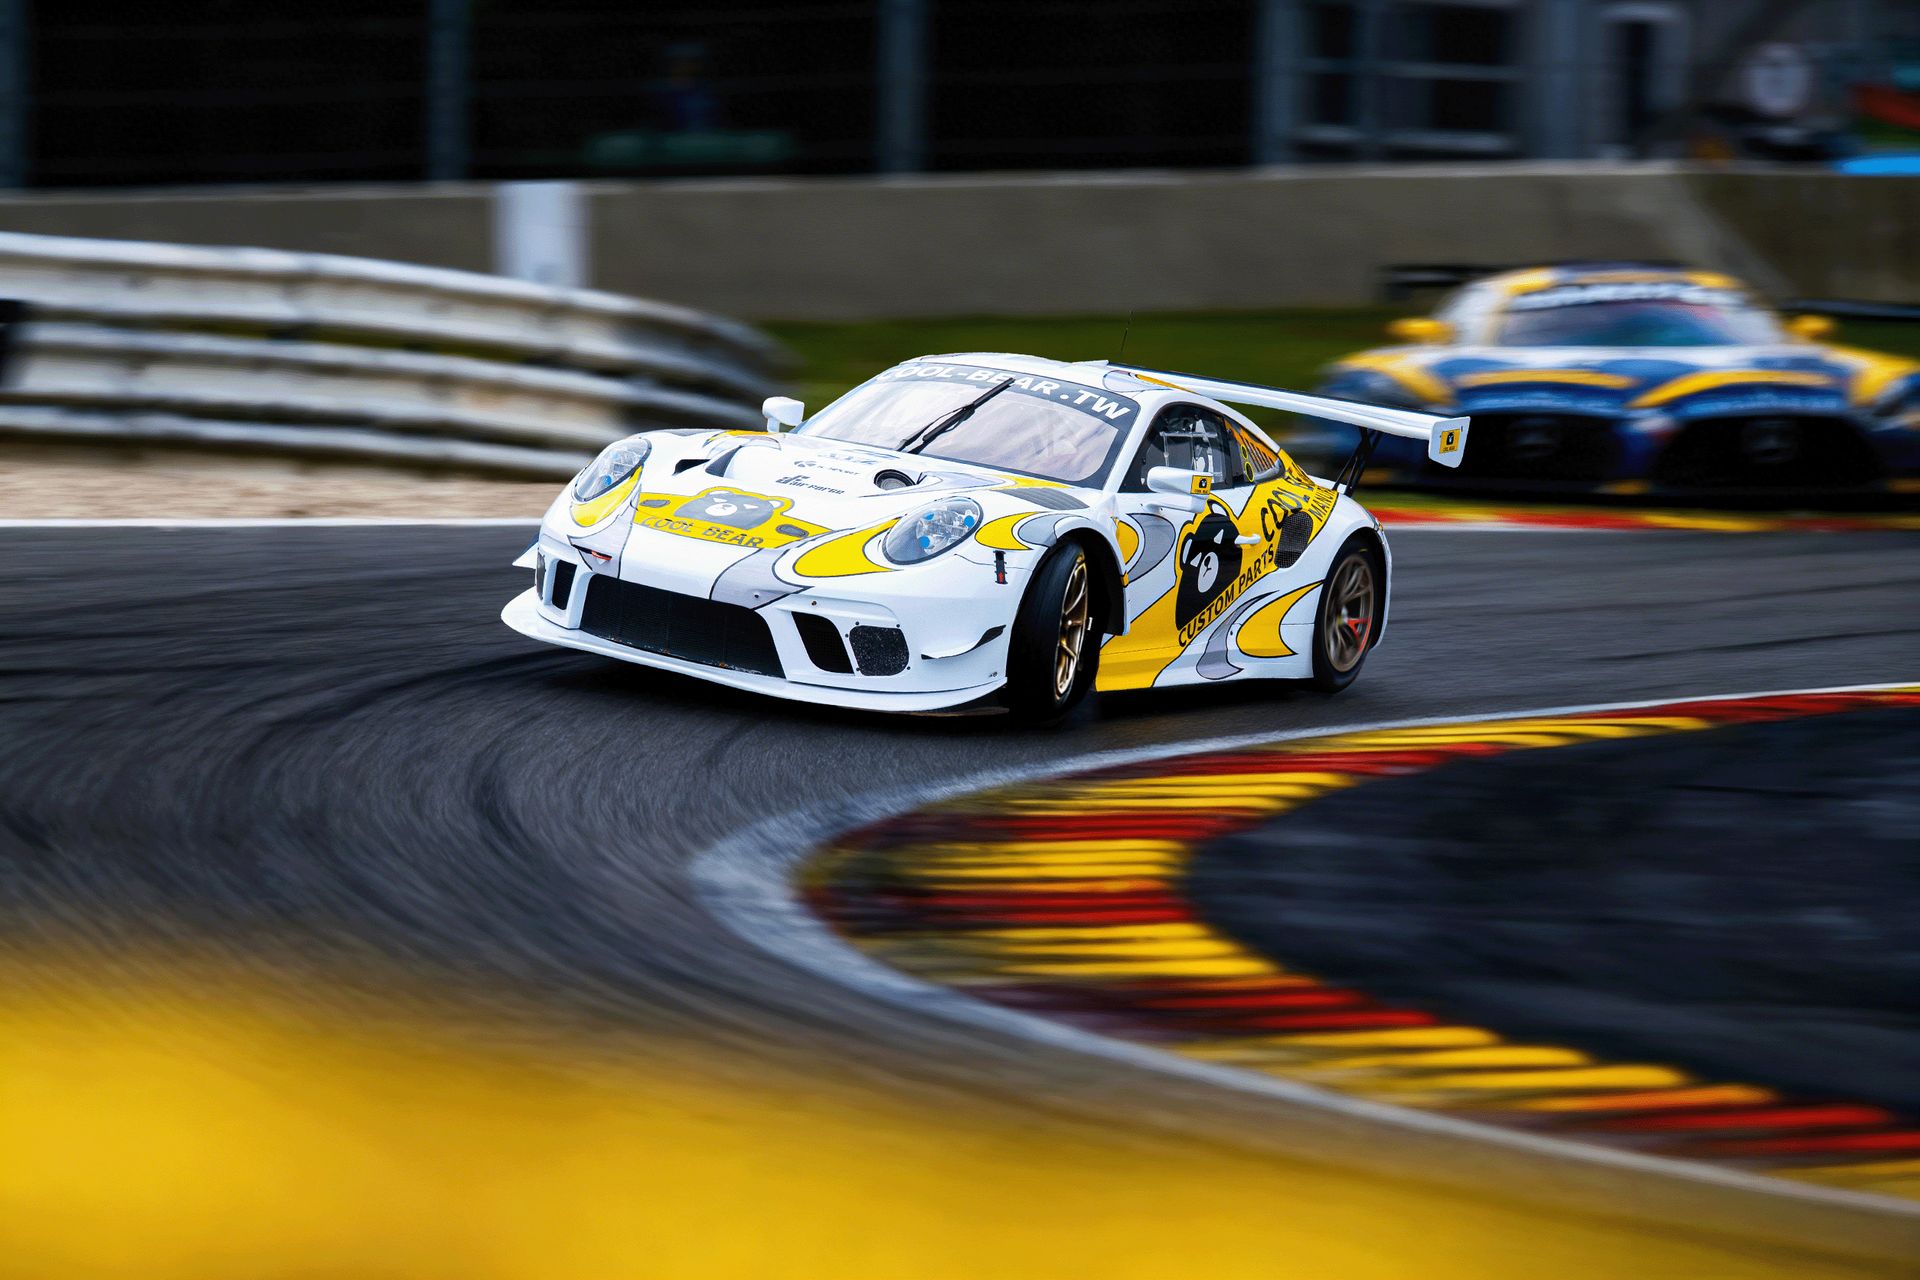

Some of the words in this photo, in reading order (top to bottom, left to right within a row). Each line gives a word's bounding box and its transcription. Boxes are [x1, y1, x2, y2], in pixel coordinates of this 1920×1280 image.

[639, 516, 694, 533] COOL
[701, 525, 765, 548] BEAR
[1178, 584, 1236, 648] CUSTOM
[1238, 543, 1275, 594] PARTS
